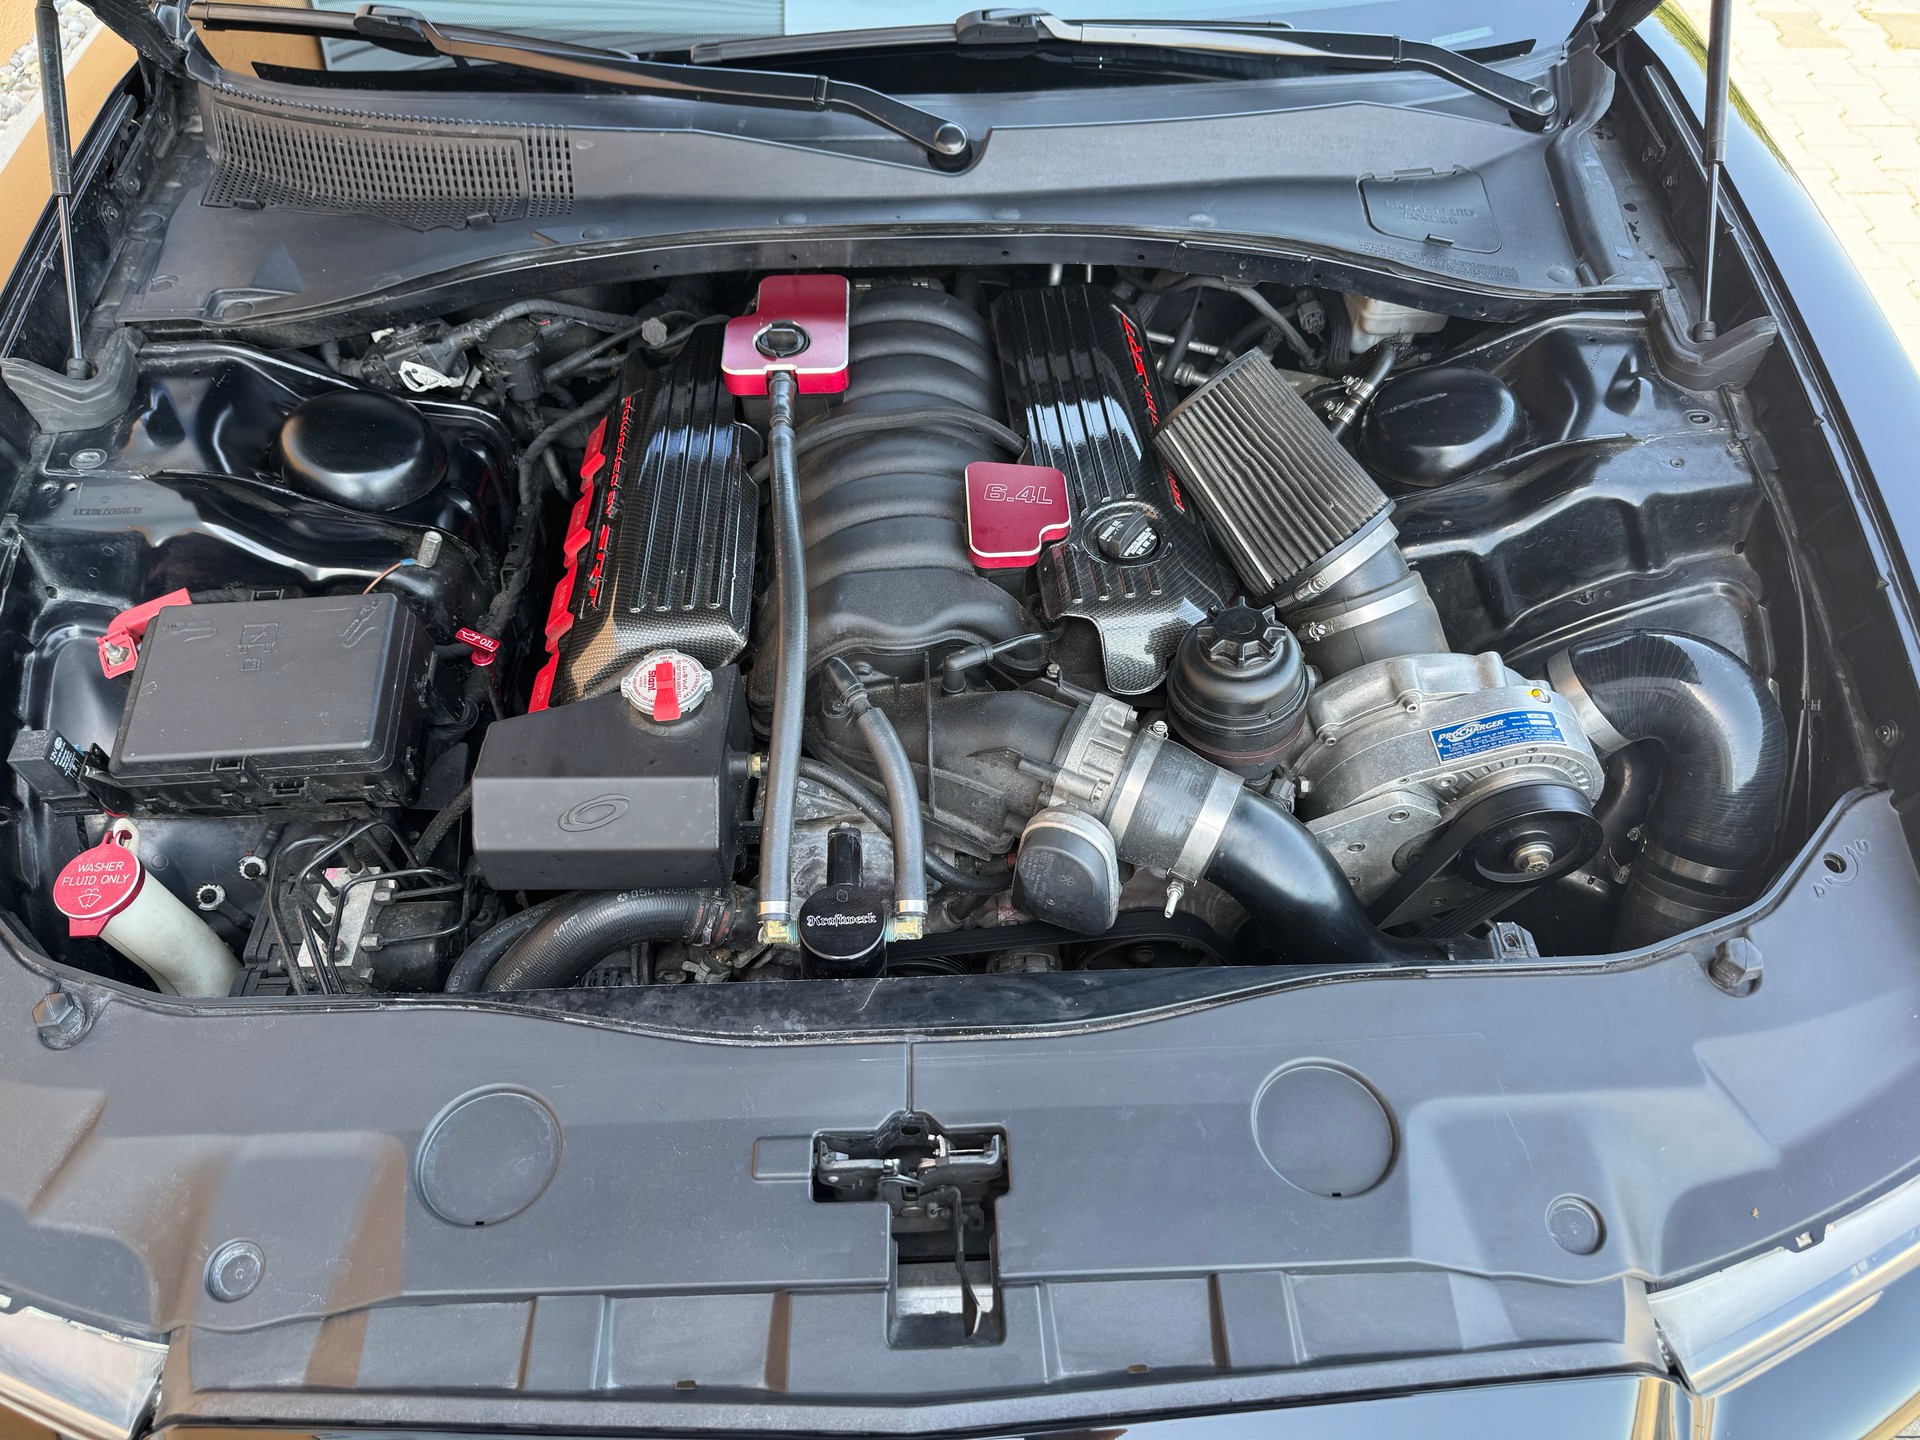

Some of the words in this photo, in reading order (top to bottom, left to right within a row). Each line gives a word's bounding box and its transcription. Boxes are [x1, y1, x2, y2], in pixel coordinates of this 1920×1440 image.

[1384, 200, 1431, 213] BRAKE
[1435, 205, 1476, 218] FLUID
[1403, 212, 1459, 225] ACCESS
[983, 483, 1053, 504] 6.4L
[479, 638, 494, 649] OIL
[648, 670, 656, 691] Stant
[1438, 719, 1505, 741] PROCHARGER
[50, 748, 58, 762] 12V
[78, 861, 124, 873] WASHER
[61, 875, 97, 886] FLUID
[100, 873, 131, 885] ONLY
[553, 914, 580, 937] 44MM
[806, 911, 877, 927] Kraftwerk
